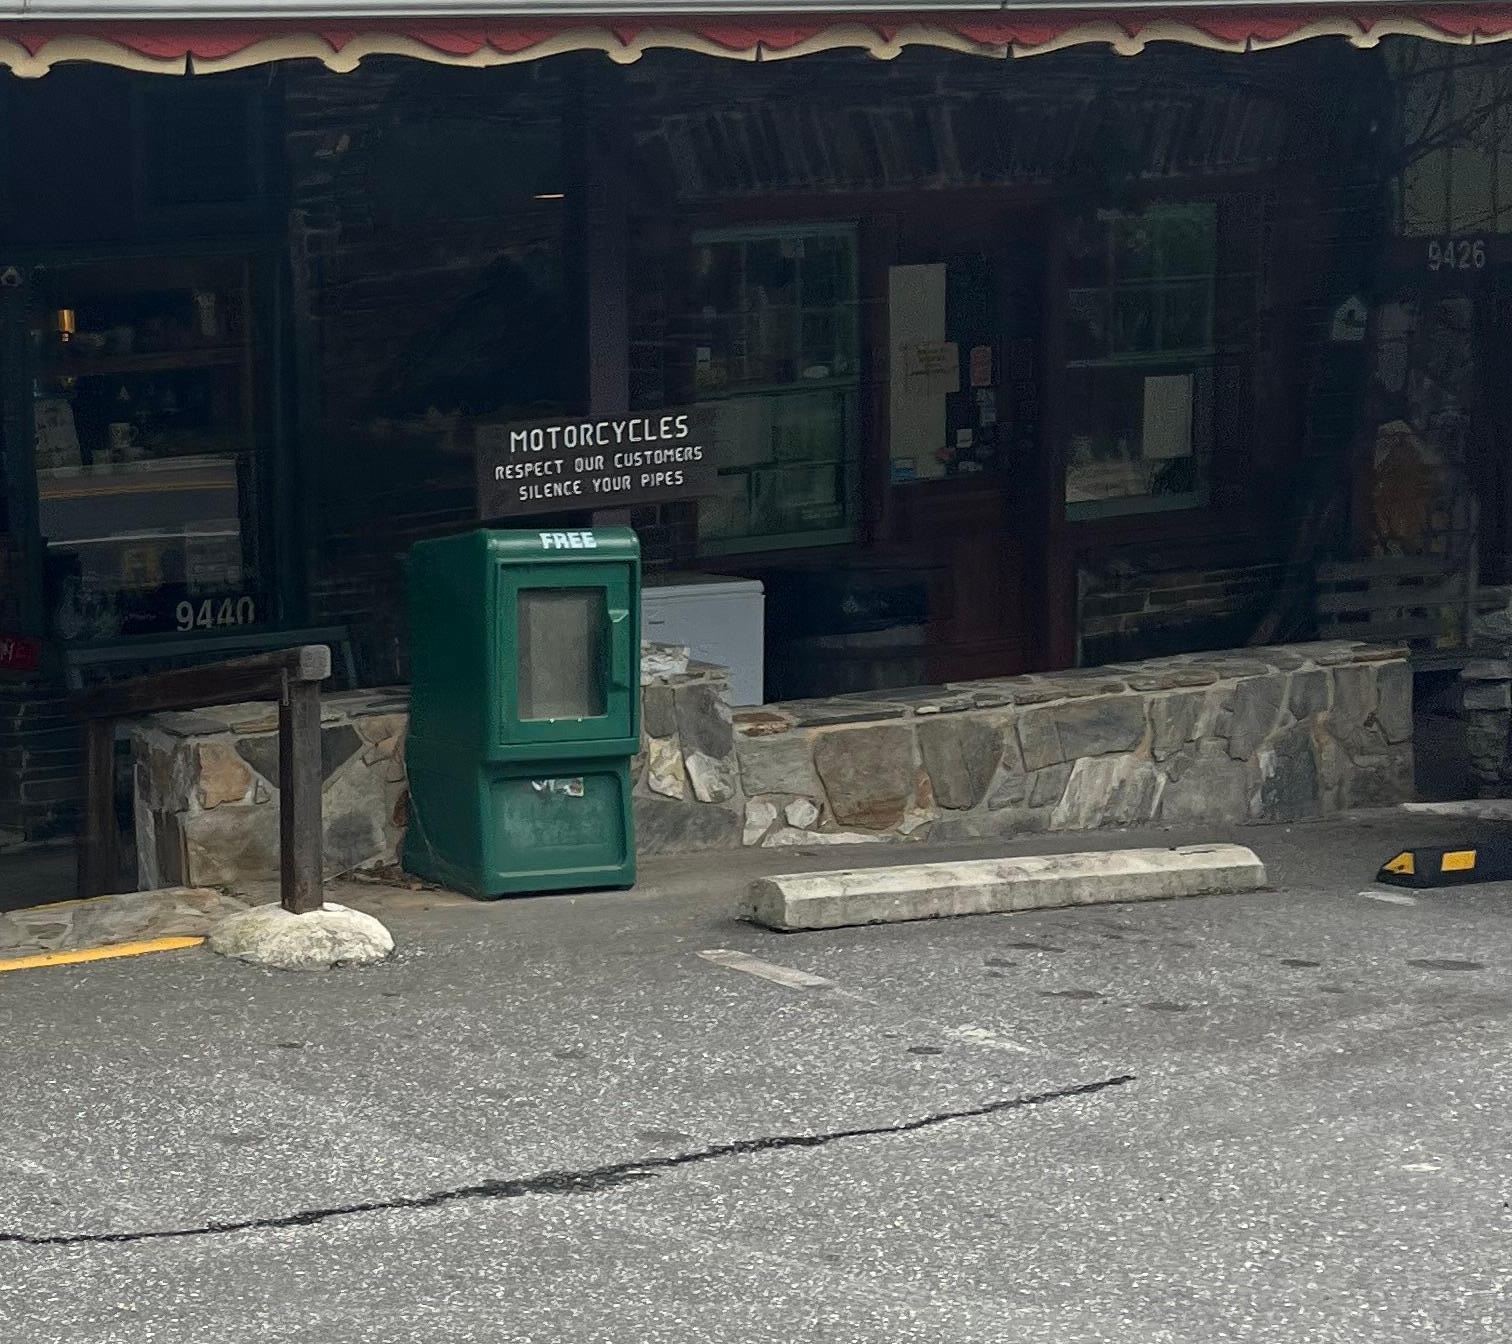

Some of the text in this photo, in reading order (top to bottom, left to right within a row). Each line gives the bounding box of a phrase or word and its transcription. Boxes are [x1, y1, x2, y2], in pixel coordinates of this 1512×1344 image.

[1427, 239, 1486, 271] 9426
[509, 414, 689, 454] MOTORCYCLES
[494, 444, 704, 481] RESPECT OUR CUSTOMERS
[518, 469, 685, 502] SILENCE YOUR PIPES
[538, 530, 598, 550] FREE
[175, 594, 256, 632] 9440
